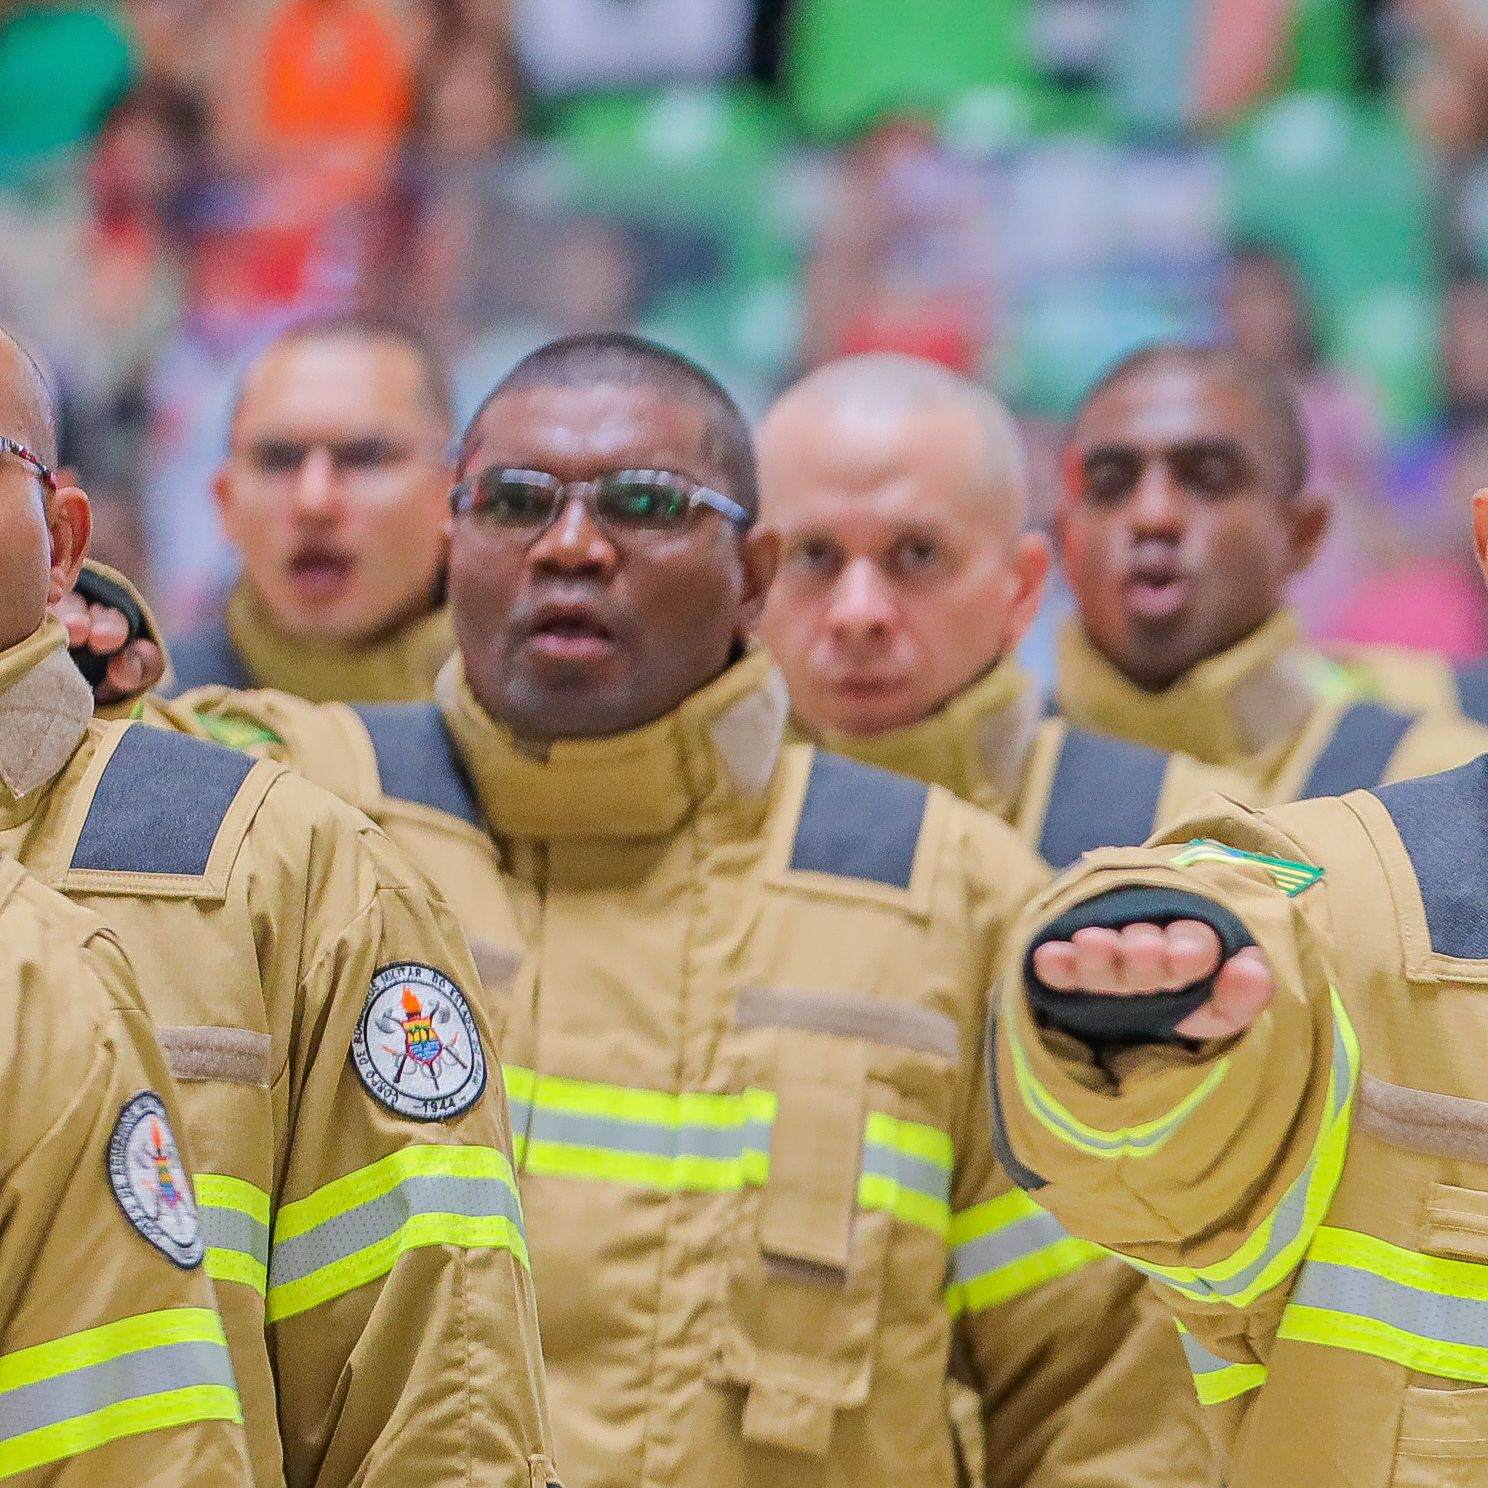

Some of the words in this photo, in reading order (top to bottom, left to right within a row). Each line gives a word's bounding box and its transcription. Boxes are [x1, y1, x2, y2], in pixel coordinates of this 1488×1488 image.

[380, 967, 421, 985] MILITAR
[356, 1050, 369, 1066] DE
[366, 1070, 399, 1108] CORPO
